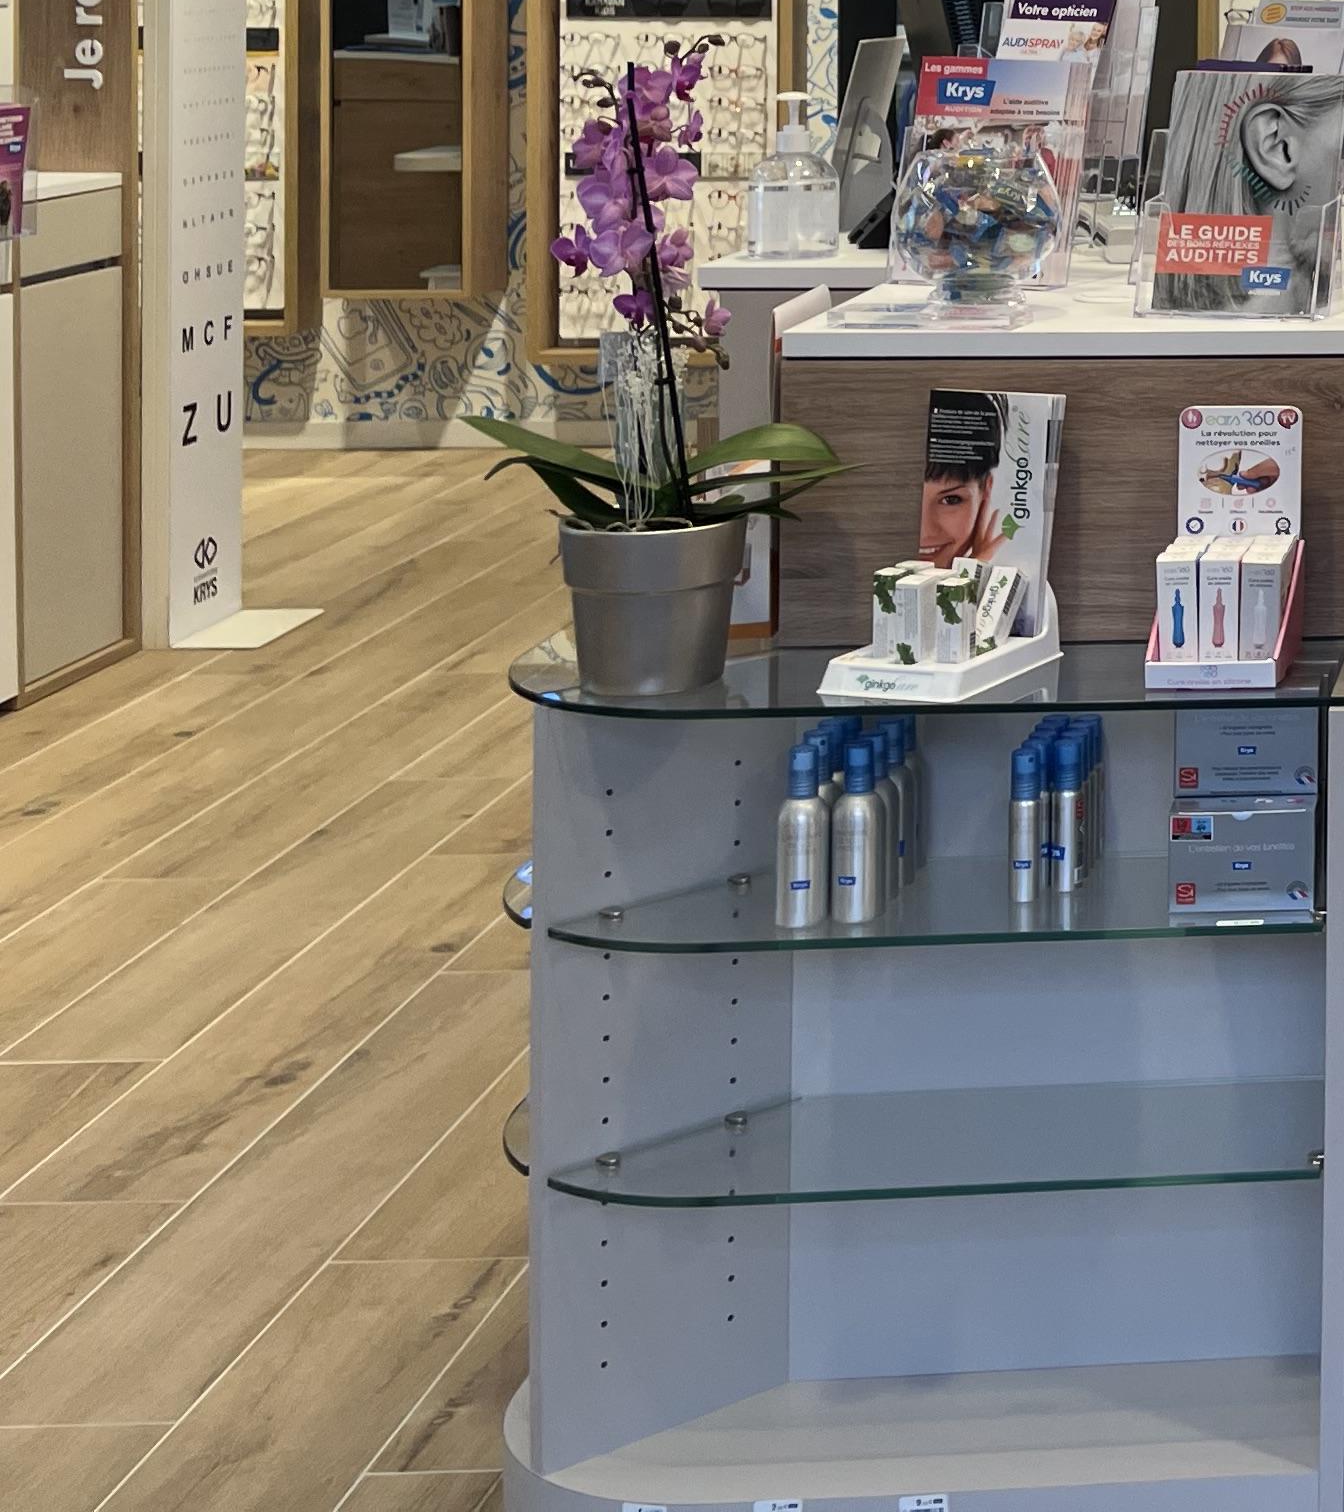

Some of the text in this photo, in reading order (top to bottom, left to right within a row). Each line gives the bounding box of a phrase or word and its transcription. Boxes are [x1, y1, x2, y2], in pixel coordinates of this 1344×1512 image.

[1018, 1, 1098, 18] Votre opticien
[1001, 37, 1064, 49] AUDISPRAY
[63, 39, 104, 89] Je
[925, 62, 984, 75] Les gammes
[945, 82, 985, 101] Krys
[1168, 225, 1262, 242] LE GUIDE
[1165, 249, 1259, 264] AUDITIFS
[1249, 270, 1282, 286] Krys
[1214, 429, 1256, 437] révolution
[1195, 439, 1231, 447] nettoyer
[1010, 456, 1033, 520] ginkgo
[193, 575, 218, 605] KRYS
[864, 676, 896, 692] ginkgo
